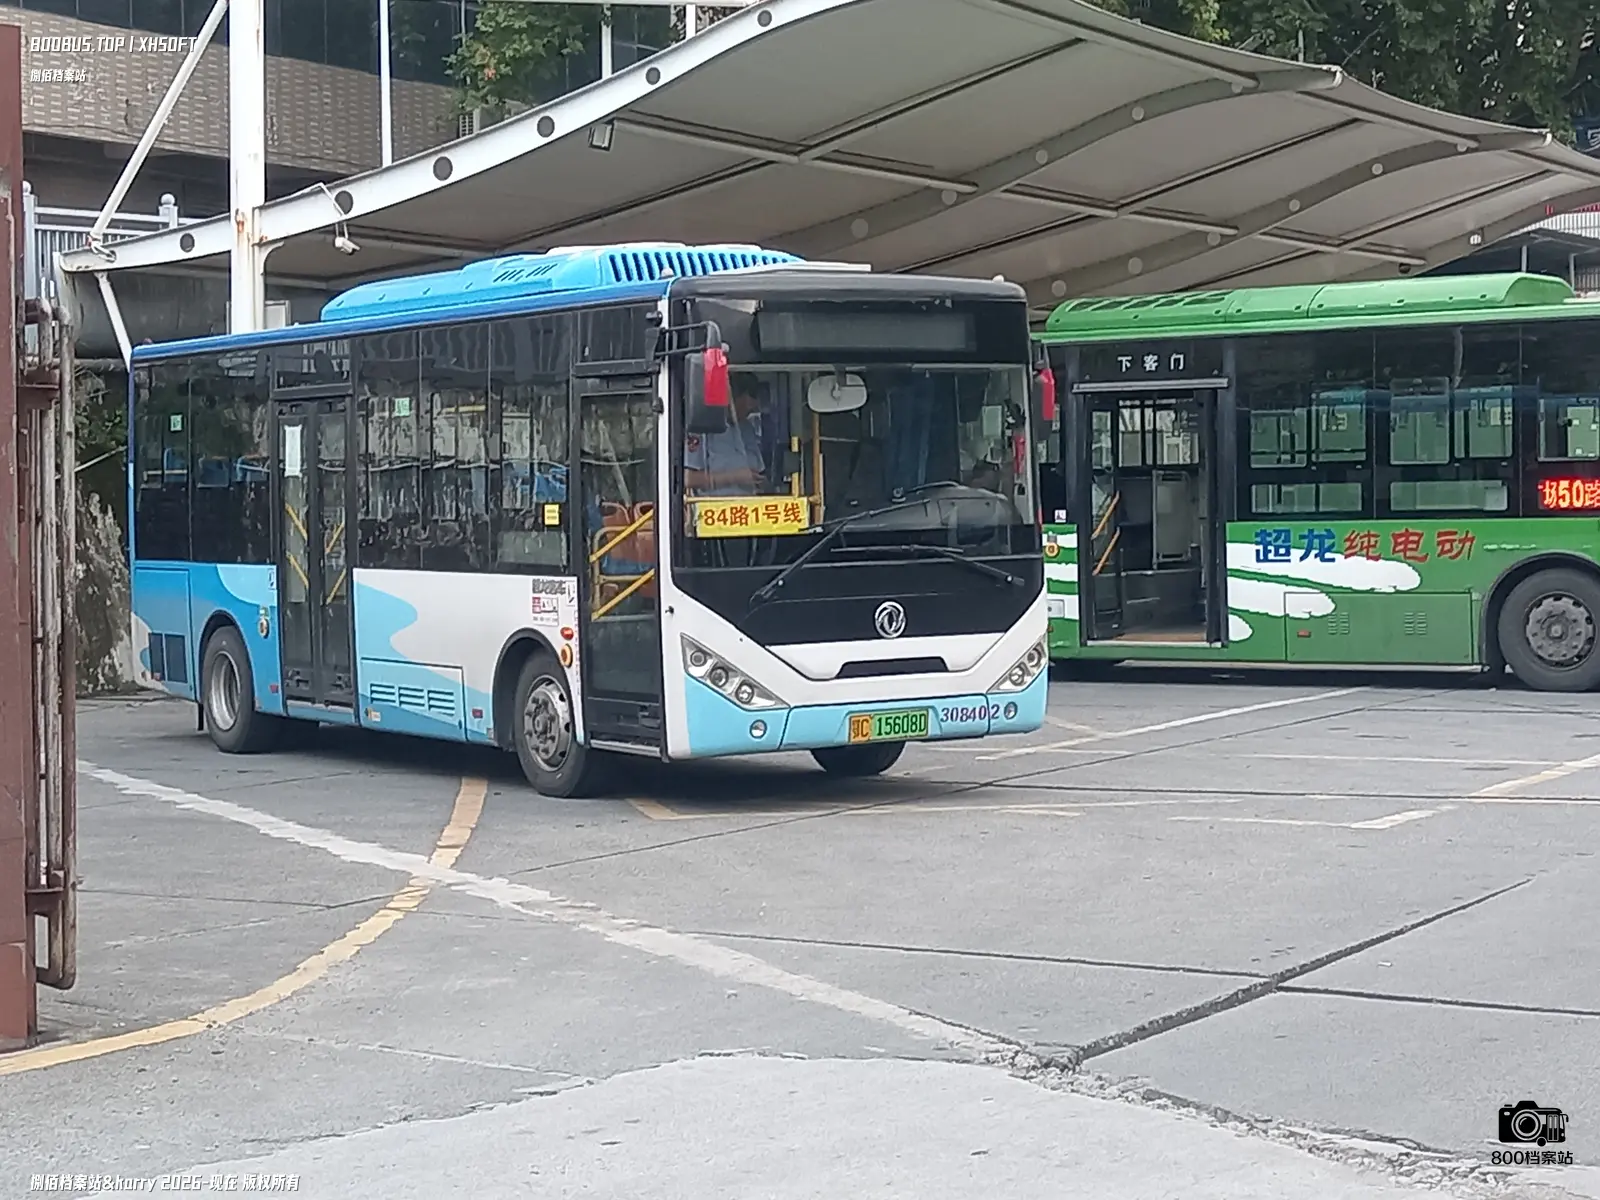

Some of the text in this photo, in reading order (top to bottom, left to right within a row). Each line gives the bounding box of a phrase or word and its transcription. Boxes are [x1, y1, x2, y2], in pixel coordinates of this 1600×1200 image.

[1117, 353, 1184, 372] 下客门
[703, 502, 802, 527] 84路1号线
[1254, 528, 1477, 563] 超龙纯电动
[940, 704, 1000, 723] 308402
